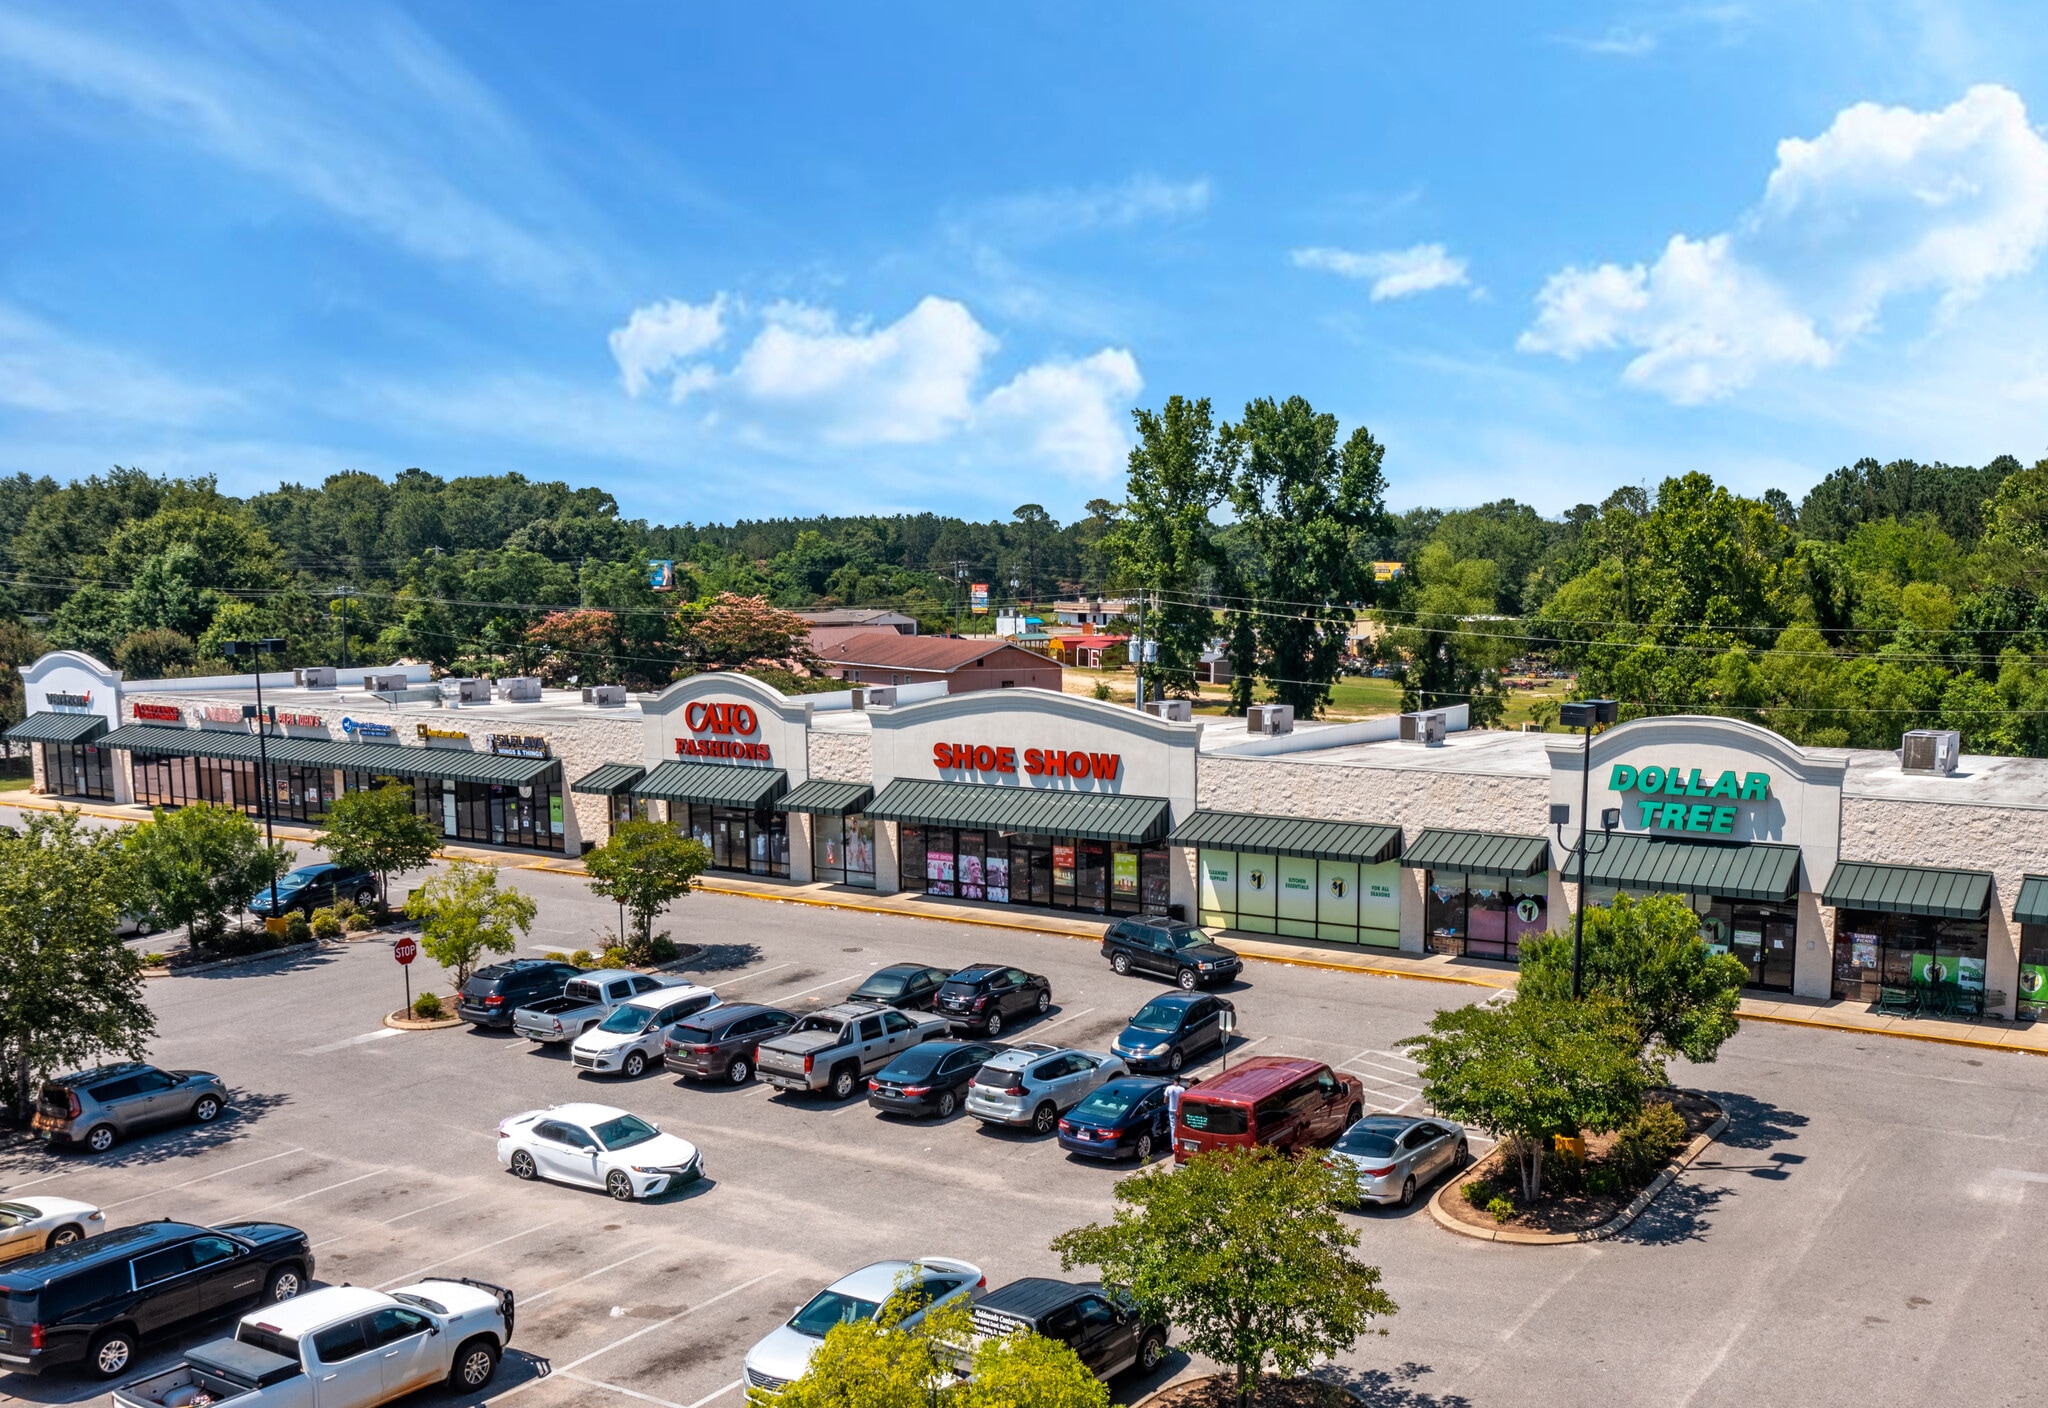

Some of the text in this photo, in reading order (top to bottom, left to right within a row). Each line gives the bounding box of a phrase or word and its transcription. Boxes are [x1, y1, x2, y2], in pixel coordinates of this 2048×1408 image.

[277, 712, 295, 724] PAPA
[684, 702, 758, 736] CATO
[675, 738, 770, 761] FASHIONS
[933, 742, 1120, 780] SHOE SHOW
[1608, 764, 1771, 801] DOLLAR
[1637, 800, 1739, 834] TREE
[395, 945, 415, 958] STOP
